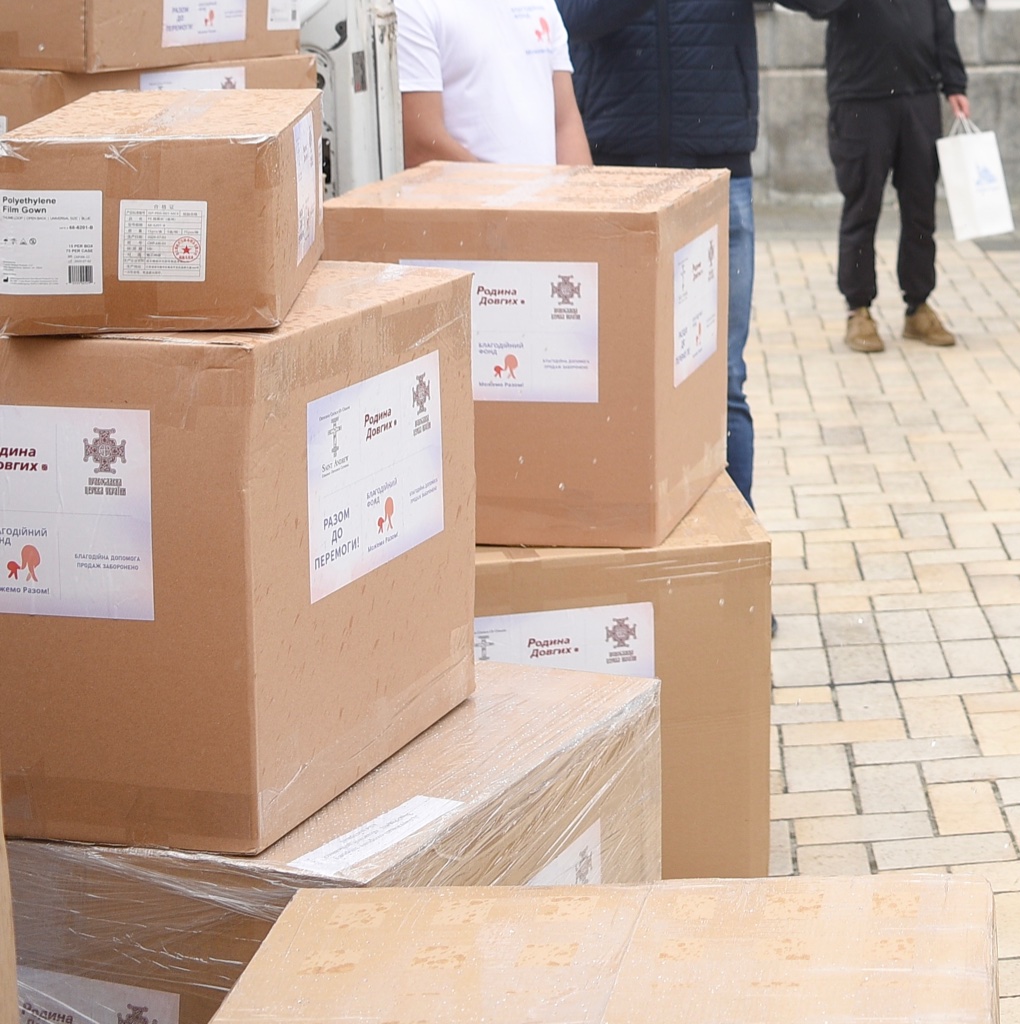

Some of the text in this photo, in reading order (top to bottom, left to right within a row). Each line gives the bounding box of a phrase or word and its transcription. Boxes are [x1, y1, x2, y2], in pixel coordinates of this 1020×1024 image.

[3, 195, 56, 205] Polyethylene
[477, 286, 517, 296] Родина
[479, 297, 517, 306] Довгих
[364, 408, 392, 427] Родина
[366, 421, 393, 442] Довгих
[0, 447, 36, 458] дина
[0, 461, 38, 471] овгих
[323, 507, 350, 530] РАЗОМ
[0, 527, 48, 537] ГОДІЙНИЙ
[331, 526, 343, 546] ДО
[314, 535, 360, 571] ПЕРЕМОГИ!
[103, 563, 139, 571] ЗАБОРОНЕНО
[22, 587, 50, 595] Разом!
[527, 637, 571, 648] Родина
[530, 647, 572, 659] Довгих
